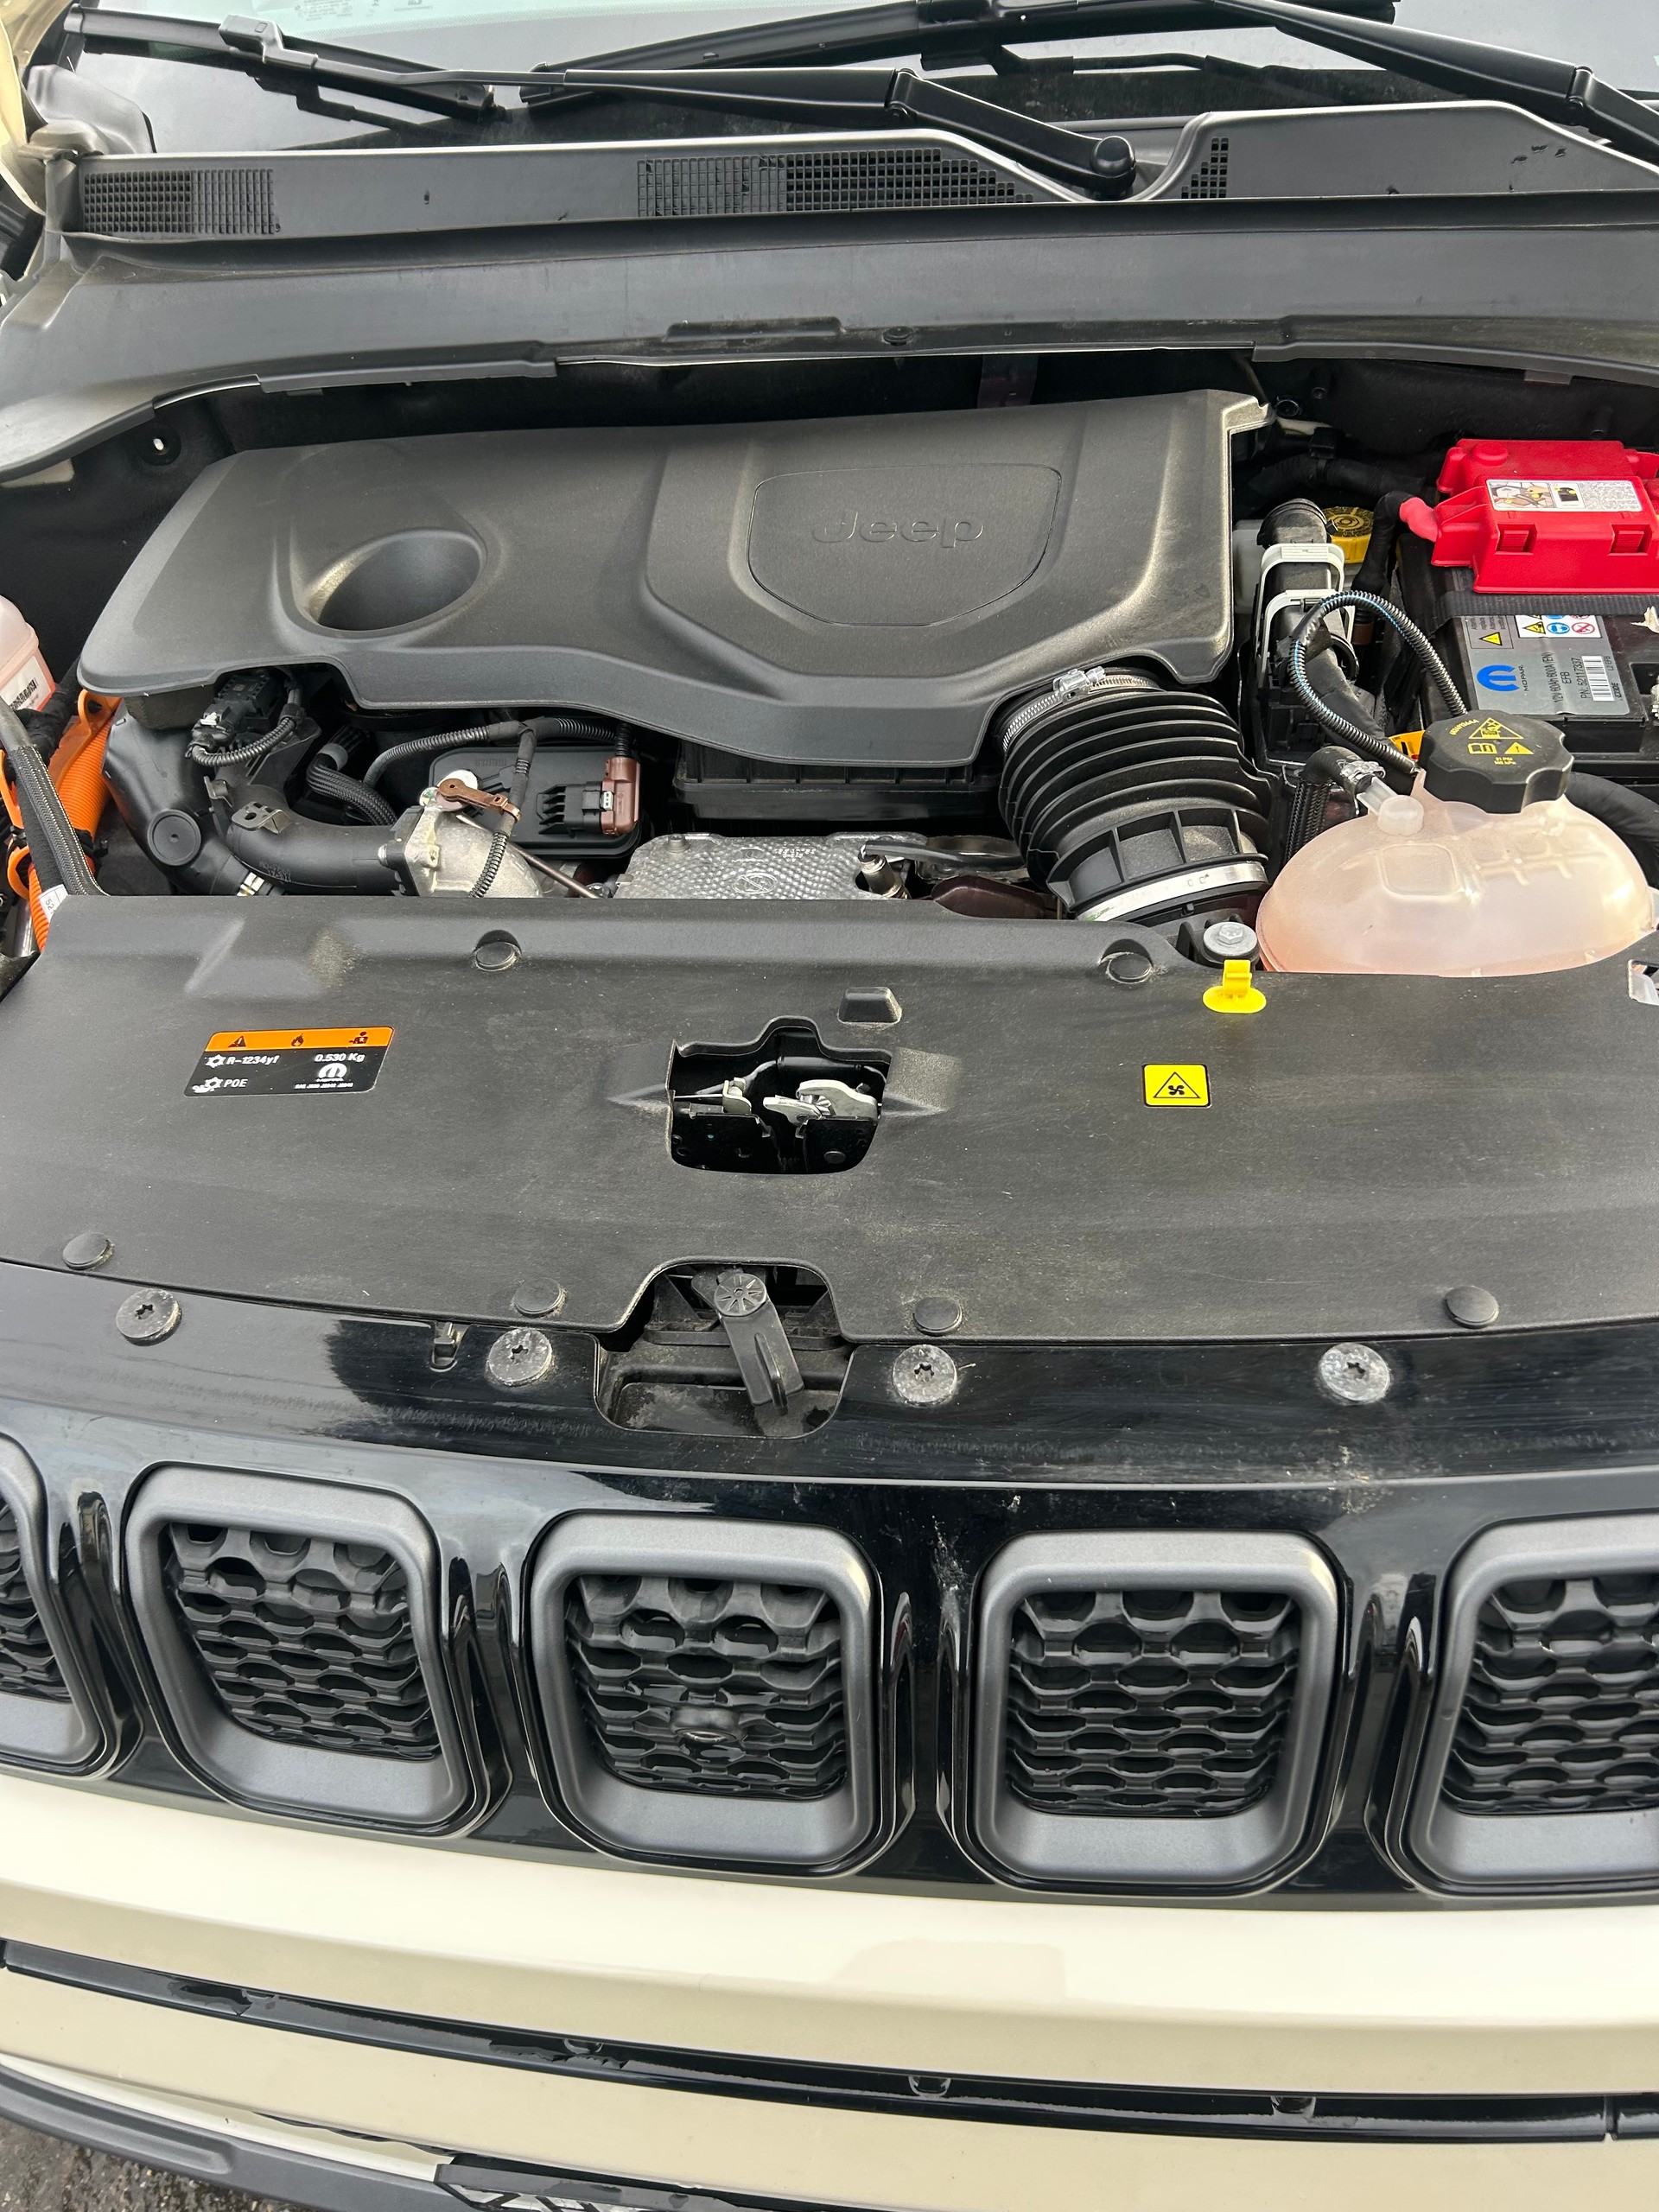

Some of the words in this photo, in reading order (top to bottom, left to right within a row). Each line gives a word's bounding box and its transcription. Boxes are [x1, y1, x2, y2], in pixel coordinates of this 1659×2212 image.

[812, 512, 984, 549] Jeep
[1518, 664, 1529, 692] MOPAR
[1560, 671, 1572, 684] EFB
[1551, 693, 1564, 702] 12V
[226, 1055, 280, 1065] R-1234yf
[315, 1053, 346, 1062] 0.530
[348, 1052, 365, 1063] Kg
[224, 1078, 248, 1088] POE
